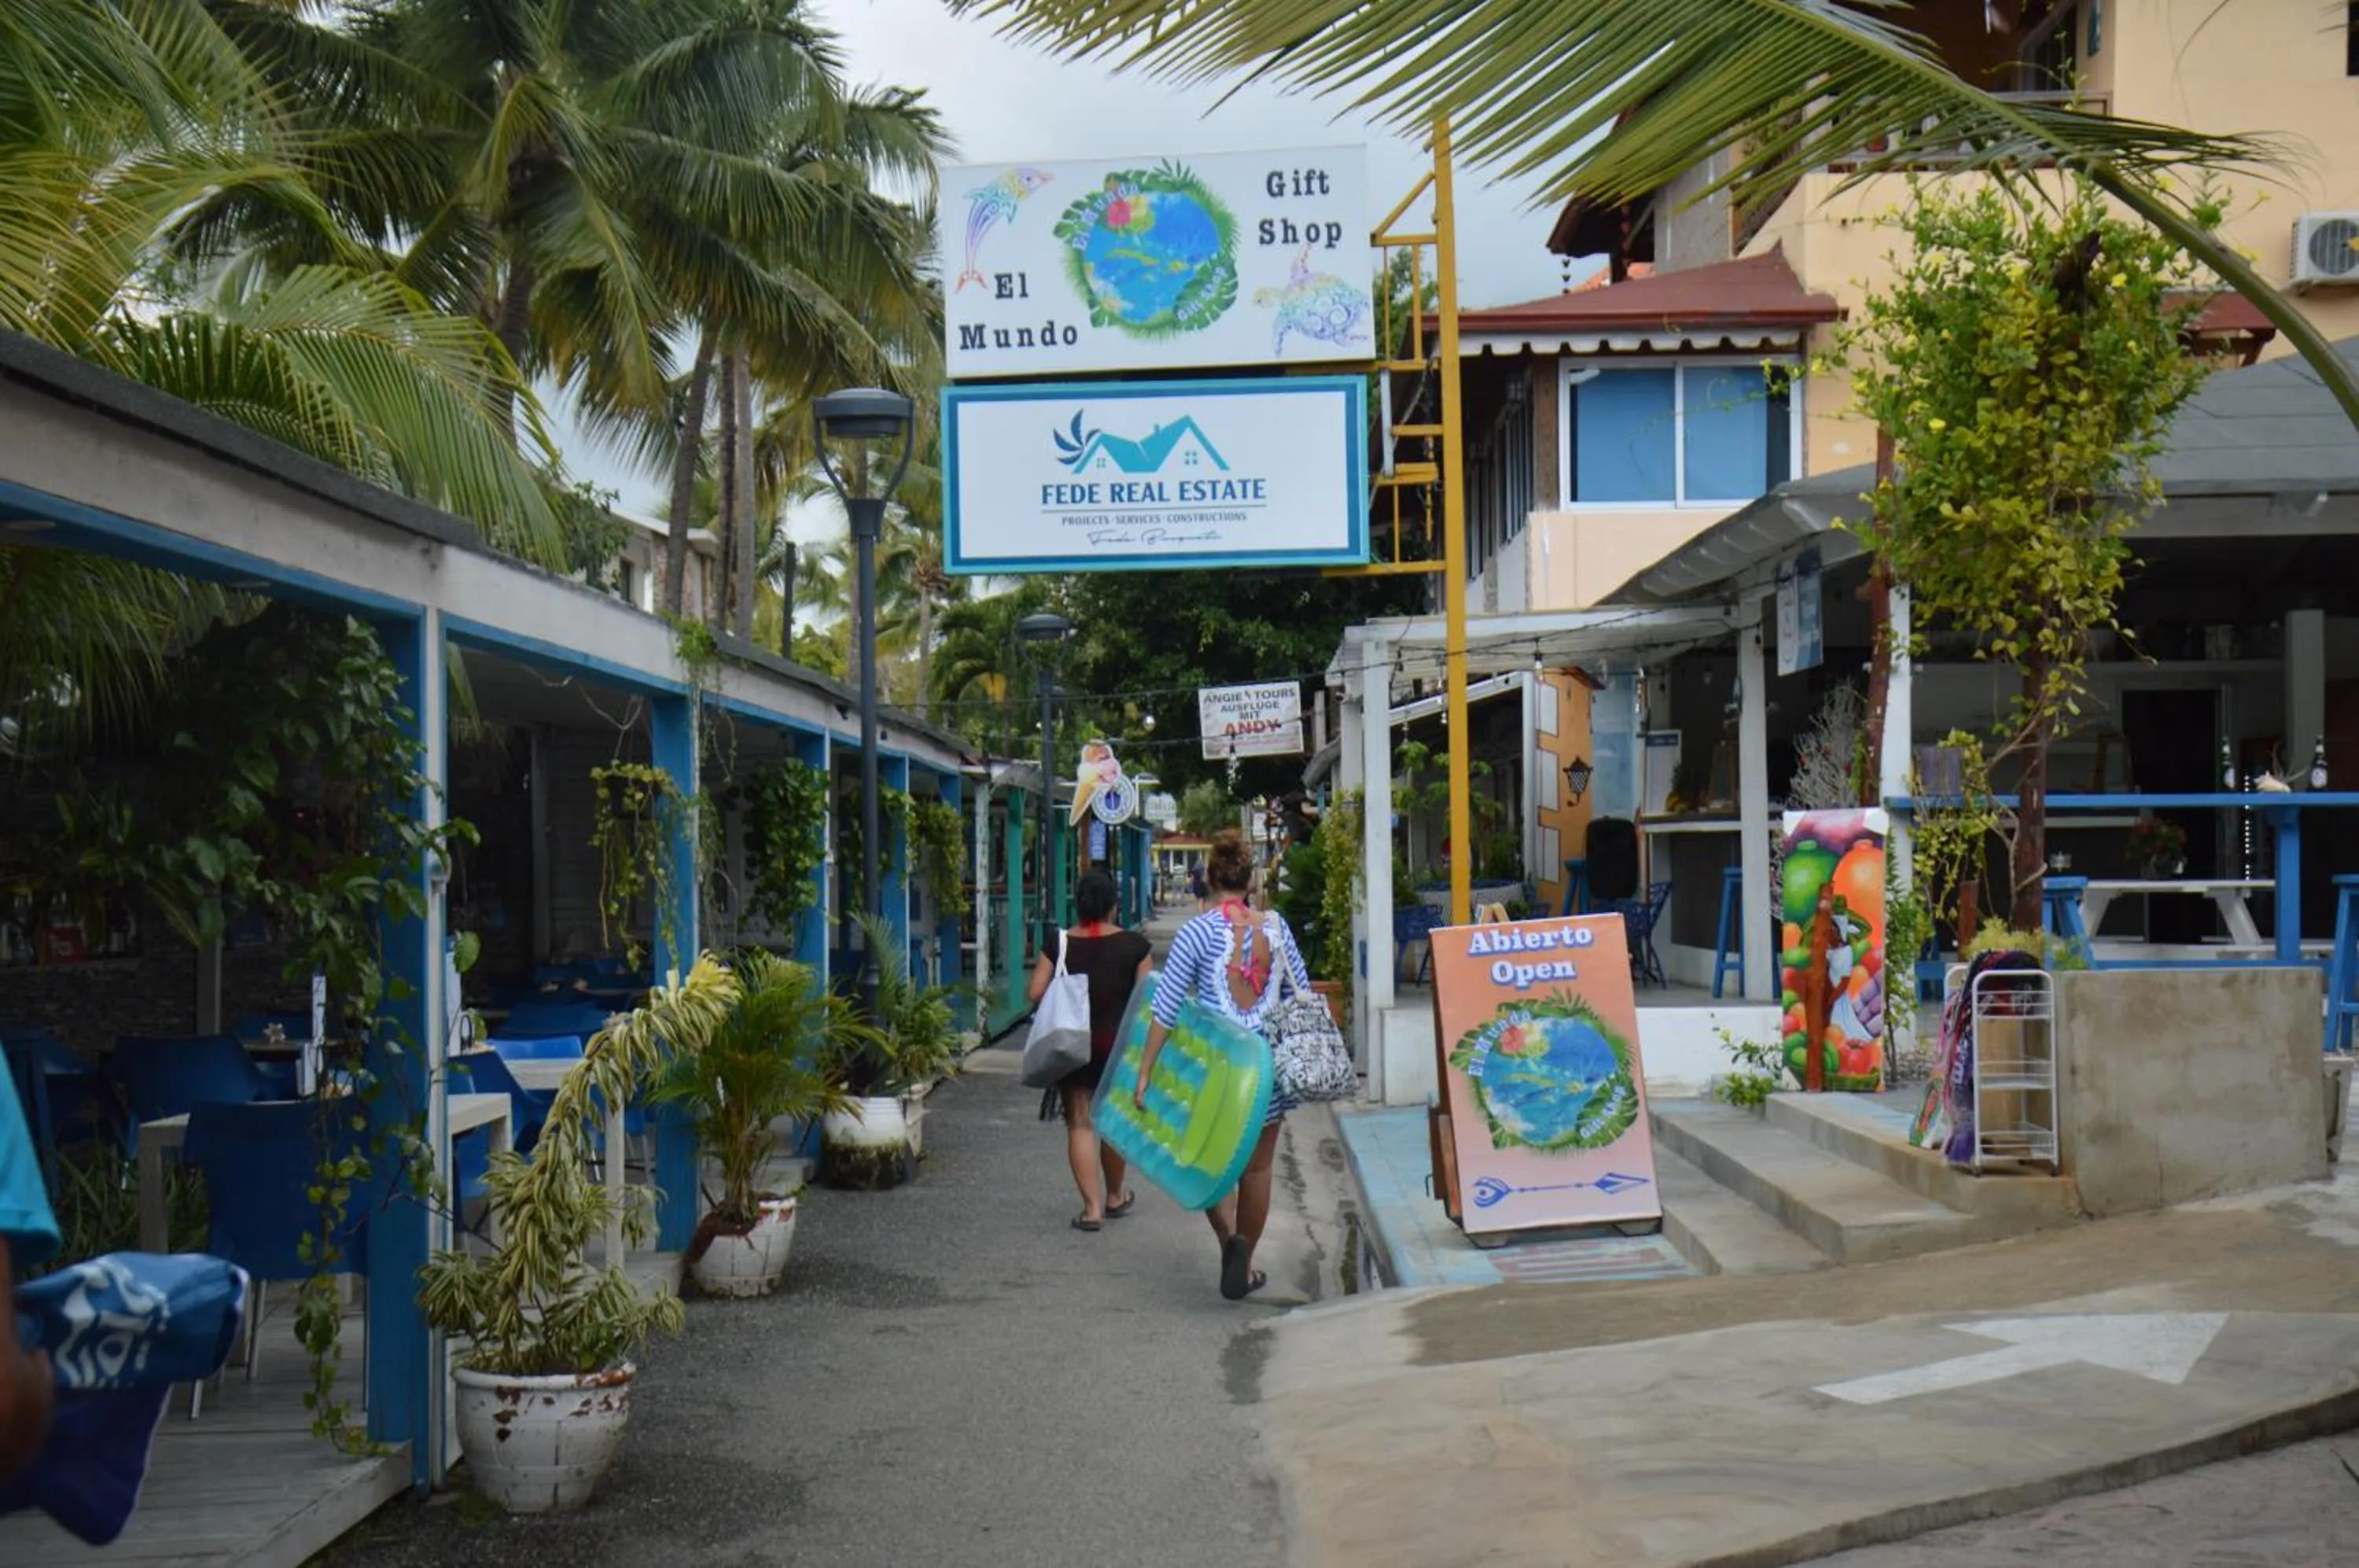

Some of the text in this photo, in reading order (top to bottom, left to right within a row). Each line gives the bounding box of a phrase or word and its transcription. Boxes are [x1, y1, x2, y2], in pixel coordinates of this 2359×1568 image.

[1265, 169, 1330, 198] Gift
[1259, 219, 1343, 247] Shop
[994, 273, 1029, 299] El
[959, 320, 1079, 351] Mundo
[1041, 478, 1268, 505] FEDE REAL ESTATE
[1254, 688, 1296, 700] TOURS
[1225, 720, 1280, 735] ANDY
[1240, 710, 1261, 720] MIT
[1468, 926, 1595, 956] Abierto
[1491, 959, 1577, 989] Open
[1468, 1010, 1532, 1077] El Mundo
